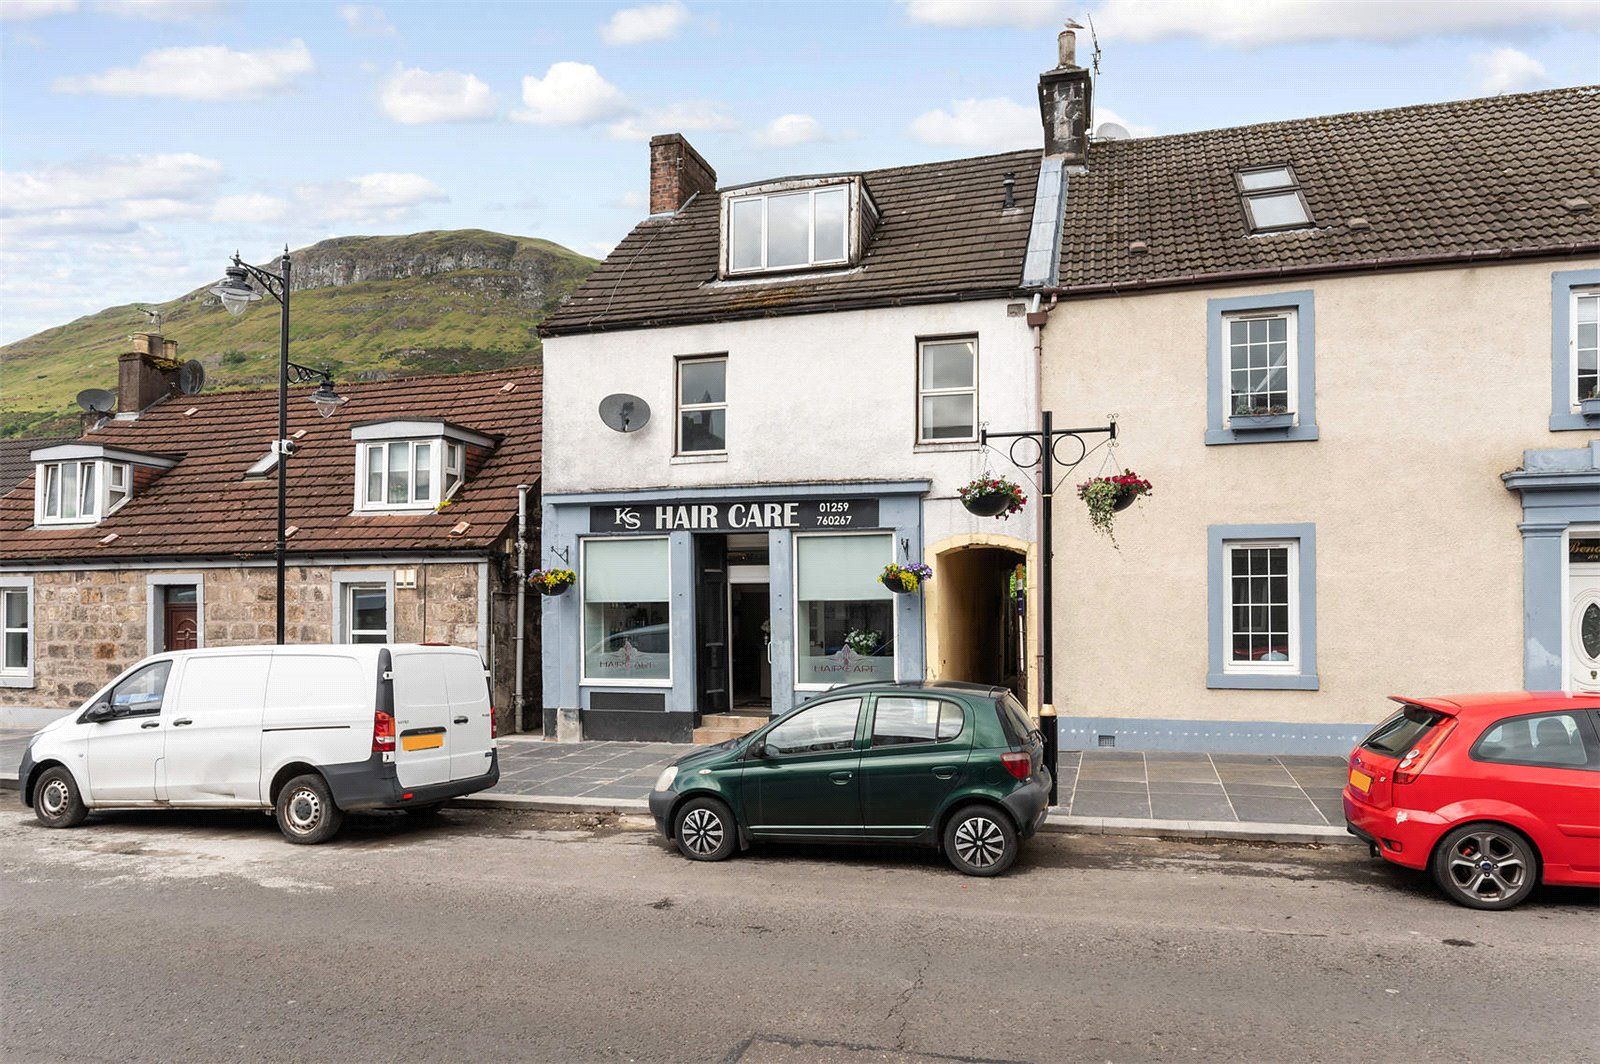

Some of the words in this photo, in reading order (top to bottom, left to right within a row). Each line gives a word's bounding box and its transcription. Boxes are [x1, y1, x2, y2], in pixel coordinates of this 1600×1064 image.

[818, 502, 849, 513] 01259
[613, 507, 641, 530] KS
[655, 504, 719, 530] HAIR
[727, 502, 800, 529] CARE
[816, 515, 852, 526] 760267
